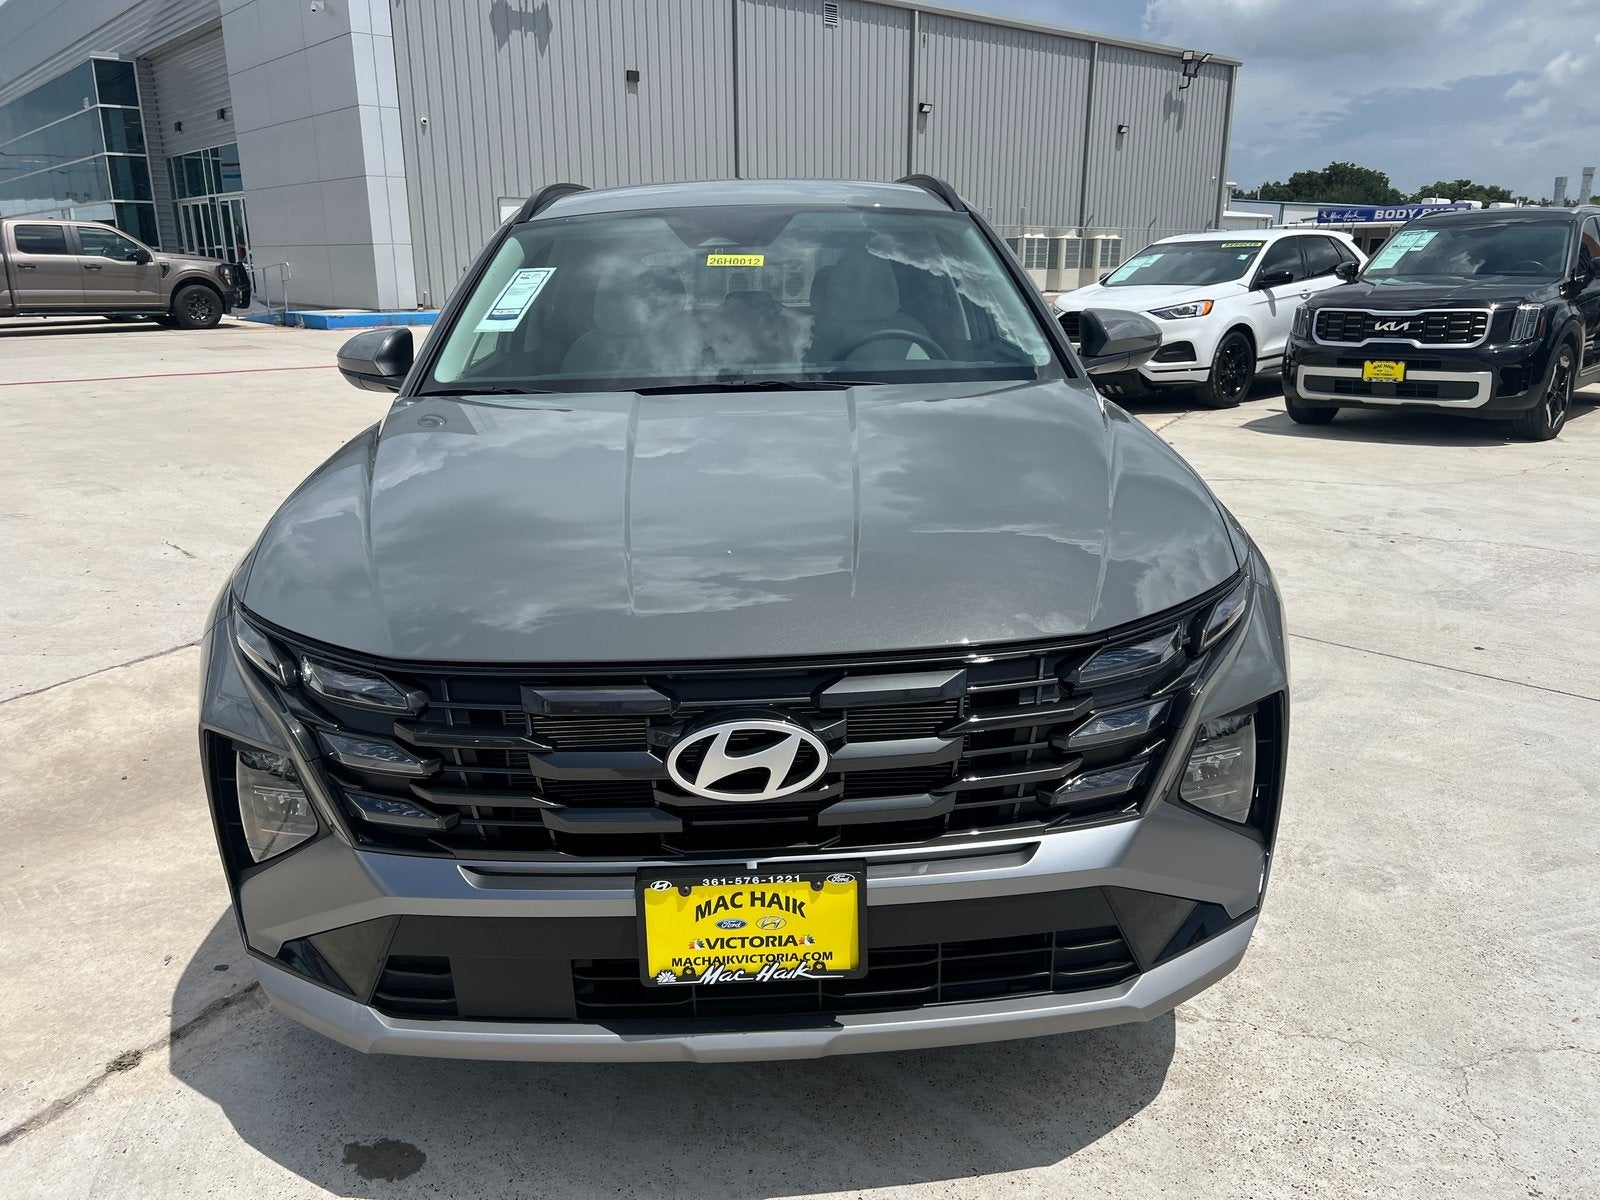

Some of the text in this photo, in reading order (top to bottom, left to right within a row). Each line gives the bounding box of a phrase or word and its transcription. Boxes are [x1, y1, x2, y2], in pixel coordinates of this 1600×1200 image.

[1374, 209, 1418, 219] BODY
[709, 257, 761, 265] 26H0012
[702, 874, 801, 887] 361-576-1221
[694, 890, 807, 923] MAC HAIK
[703, 934, 800, 950] VICTORIA
[671, 951, 834, 967] MACHAIKVICTORIA.COM
[699, 960, 812, 985] Mac Haik
